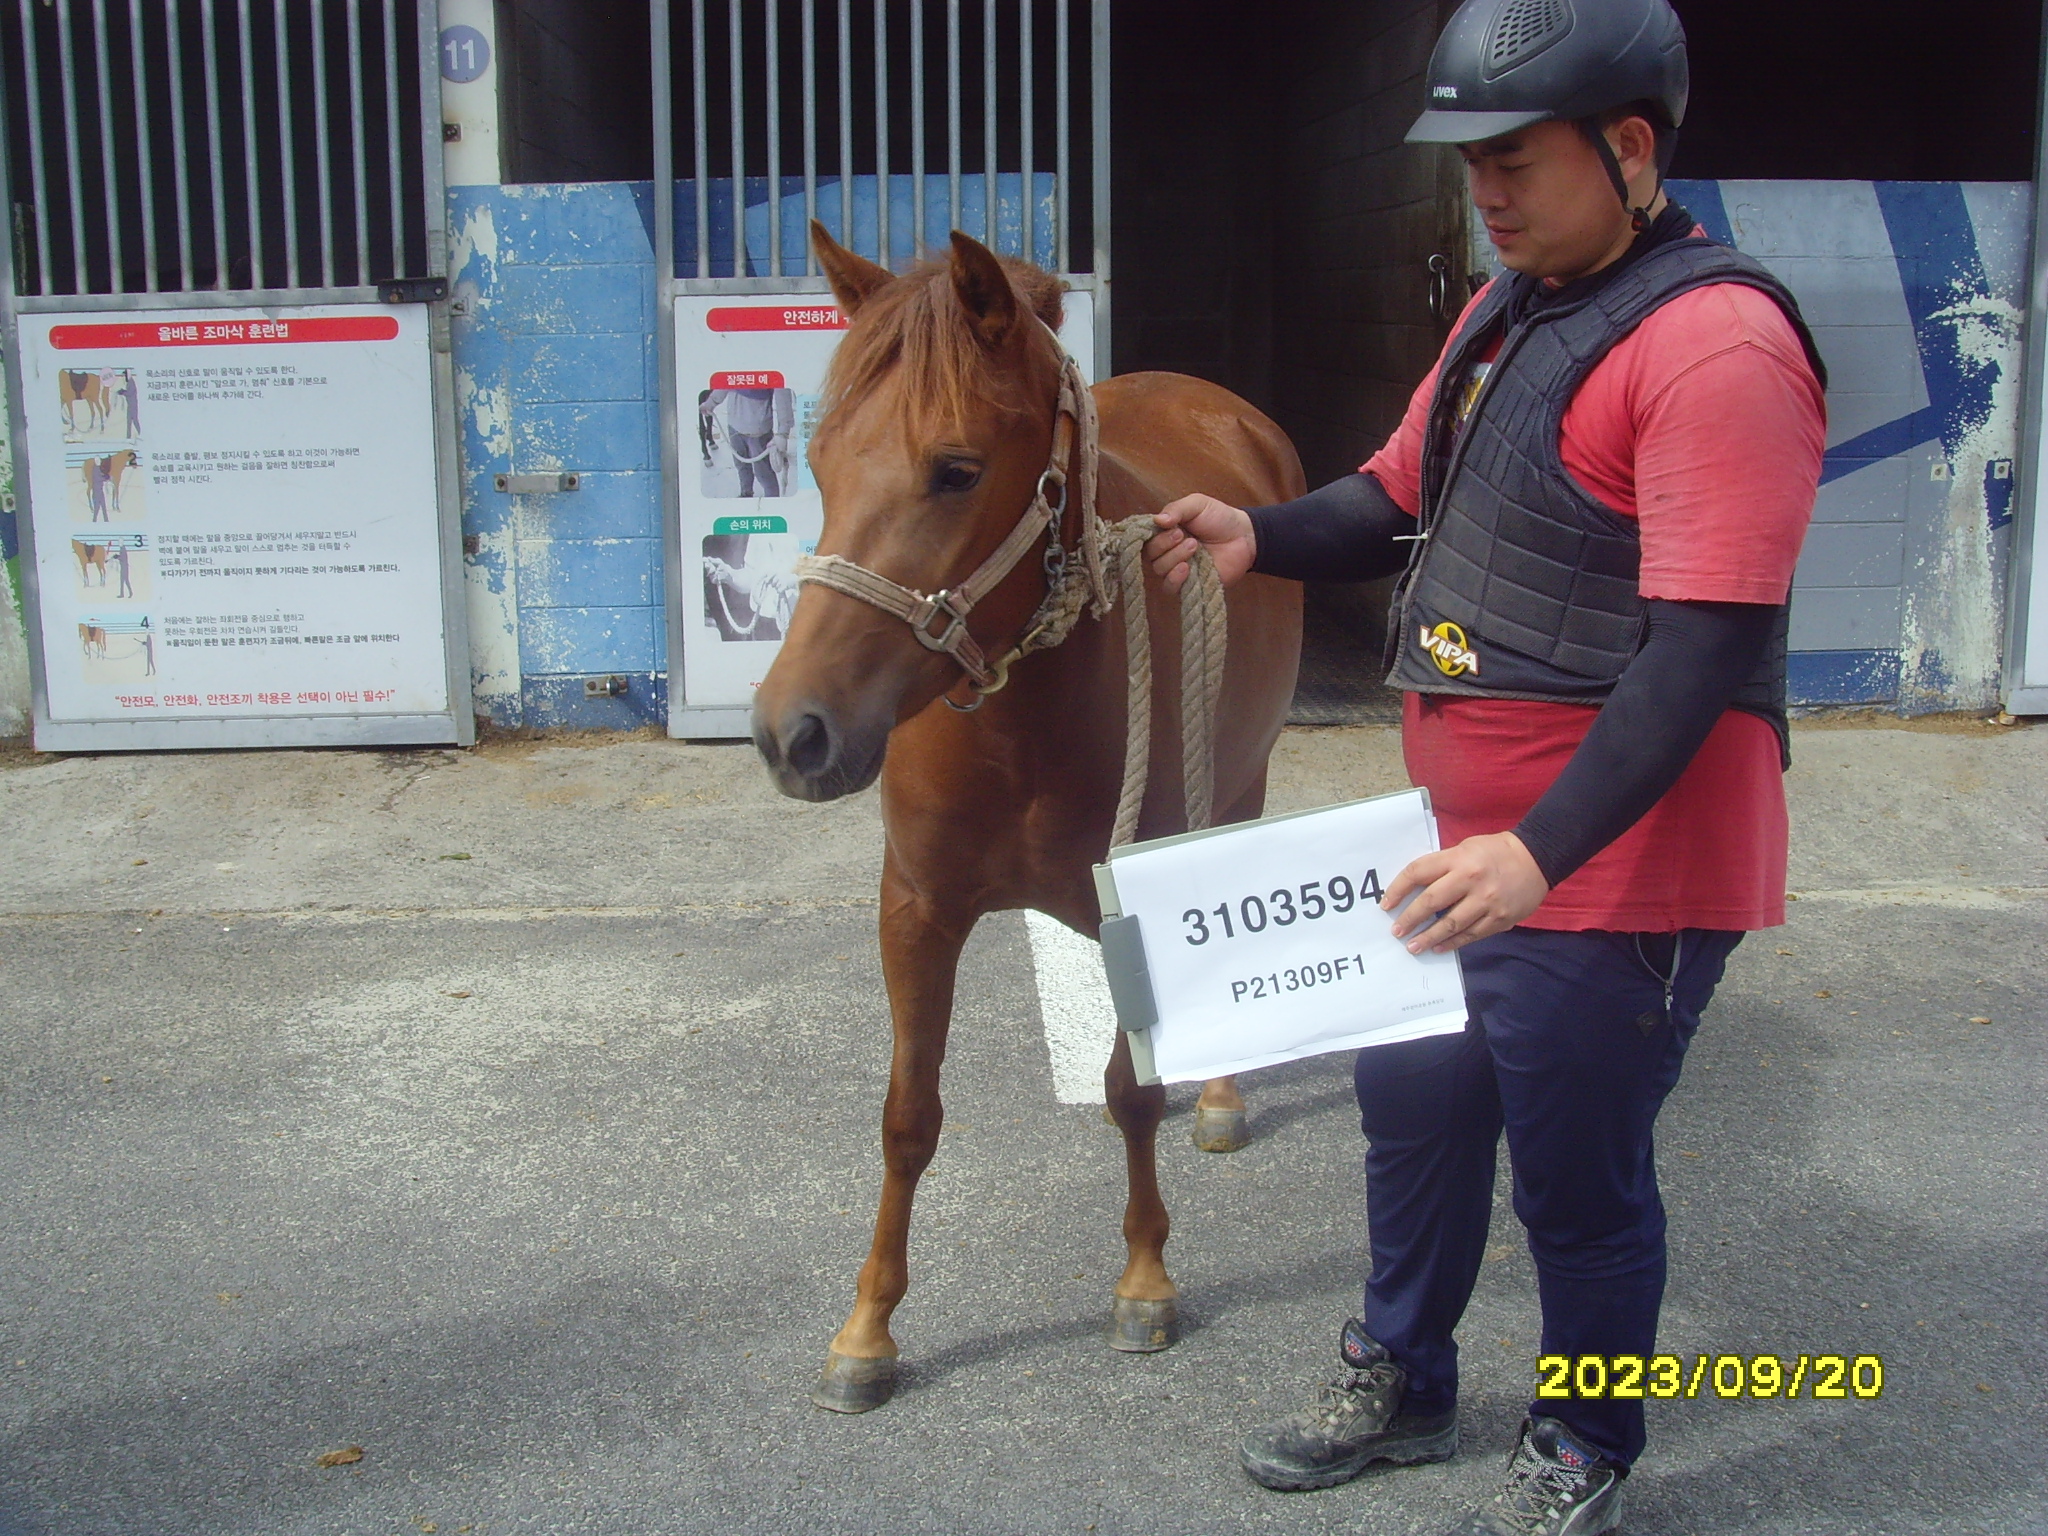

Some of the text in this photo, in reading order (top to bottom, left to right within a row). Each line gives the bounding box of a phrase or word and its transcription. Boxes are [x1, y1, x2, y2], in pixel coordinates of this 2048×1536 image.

[445, 39, 475, 70] 11
[1433, 86, 1457, 98] uvex
[783, 310, 838, 325] 안전하게
[158, 323, 289, 342] 올바른 조마삭 훈련법
[146, 366, 298, 378] 목소리의 신호로 말이 움직일 수 있도록 한다.
[147, 381, 176, 390] 지금까지
[179, 380, 208, 389] 훈련시킨
[273, 378, 295, 386] 신호를
[298, 377, 328, 385] 기본으로
[726, 374, 768, 386] 잘못된 예
[148, 393, 170, 401] 새로운
[172, 392, 195, 400] 단어를
[197, 391, 219, 400] 하나씩
[247, 390, 264, 399] 간다.
[128, 452, 137, 466] 2
[152, 453, 181, 461] 목소리로
[221, 451, 250, 459] 정지시킬
[253, 450, 260, 458] 수
[263, 450, 285, 458] 있도록
[288, 449, 302, 457] 하고
[305, 448, 327, 457] 이것이
[330, 448, 360, 456] 가능하면
[177, 463, 213, 472] 교육시키고
[216, 463, 238, 471] 원하는
[266, 461, 288, 470] 잘하면
[188, 475, 212, 483] 시킨다.
[729, 519, 771, 531] 손의 위치
[134, 534, 143, 547] 3
[206, 534, 221, 542] 말을
[224, 533, 253, 541] 중앙으로
[334, 530, 357, 539] 반드시
[210, 545, 232, 553] 세우고
[234, 544, 249, 553] 말이
[252, 544, 274, 552] 스스로
[301, 543, 316, 552] 것을
[319, 542, 341, 551] 터득할
[343, 542, 351, 551] 수
[159, 558, 181, 566] 있도록
[199, 568, 221, 577] 전까지
[224, 567, 253, 576] 움직이지
[255, 567, 277, 575] 못하게
[280, 566, 309, 574] 기다리는
[312, 566, 327, 574] 것이
[329, 565, 365, 574] 가능하도록
[368, 564, 400, 573] 가르친다.
[141, 616, 149, 629] 4
[195, 616, 217, 624] 잘하는
[251, 614, 280, 623] 중심으로
[283, 614, 304, 622] 행하고
[164, 627, 186, 636] 못하는
[189, 627, 217, 635] 우회전은
[220, 626, 235, 634] 차차
[237, 626, 267, 635] 연습시켜
[238, 637, 268, 646] 훈련자가
[336, 635, 351, 643] 조금
[1420, 626, 1477, 673] VIPA
[206, 693, 253, 706] 안전조끼
[257, 692, 292, 705] 착용은
[296, 691, 330, 704] 선택이
[336, 690, 358, 703] 아닌
[1182, 868, 1386, 946] 3103594
[1231, 954, 1366, 1003] P21309F1
